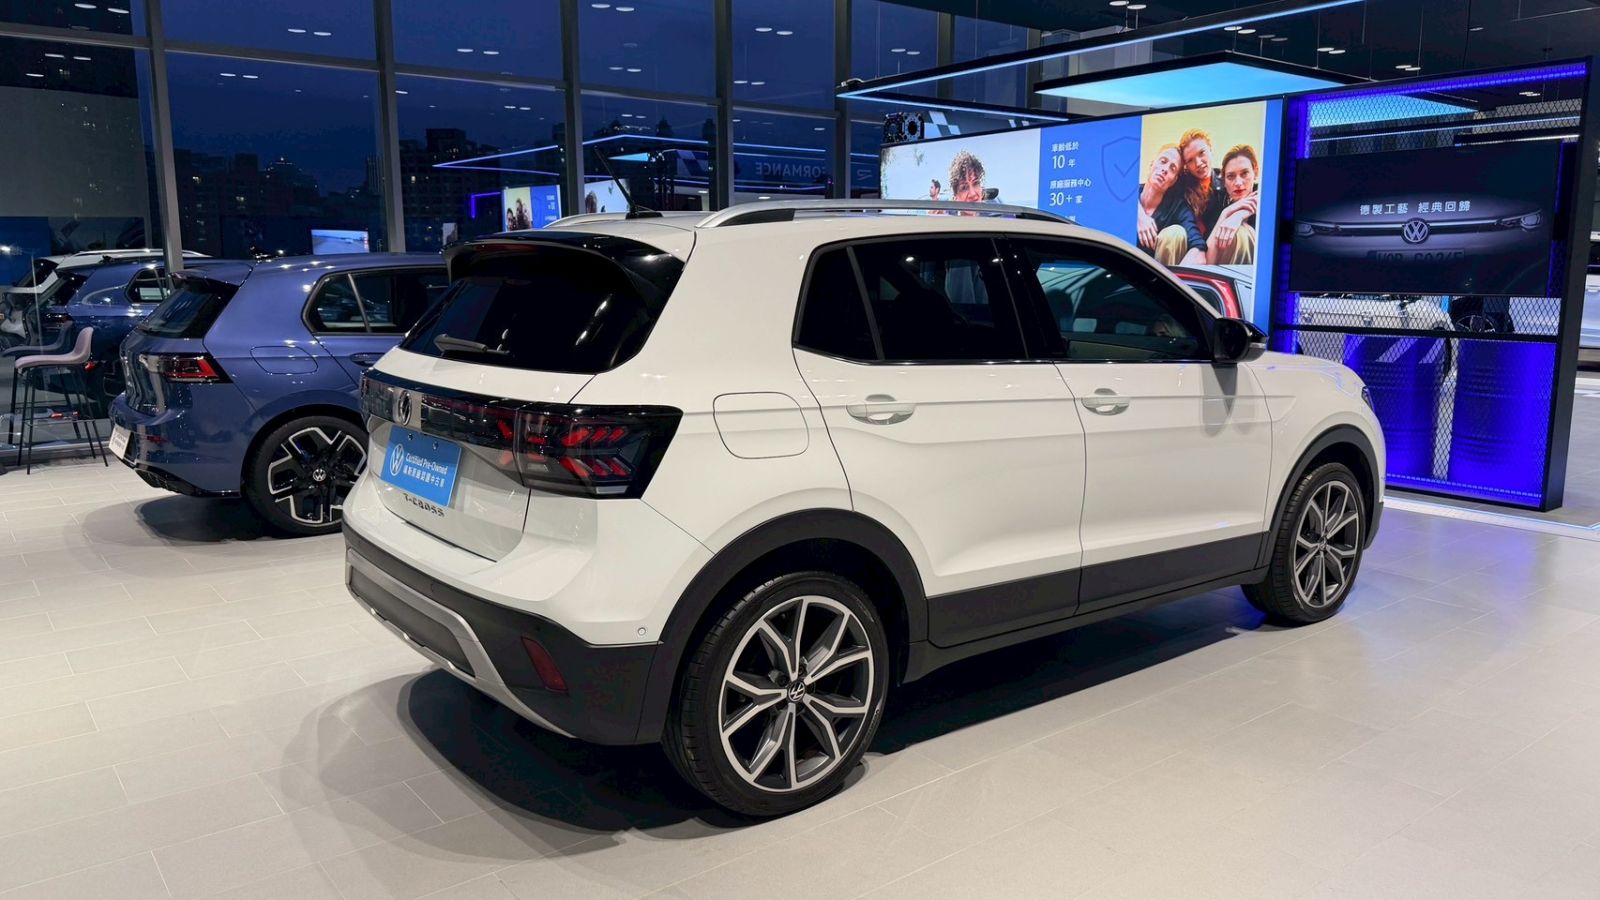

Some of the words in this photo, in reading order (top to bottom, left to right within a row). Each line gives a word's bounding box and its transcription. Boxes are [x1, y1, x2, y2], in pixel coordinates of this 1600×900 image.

[1052, 154, 1065, 169] 10
[1068, 158, 1076, 167] 年
[1359, 202, 1408, 216] 德製工藝
[1417, 200, 1471, 214] 經典回歸
